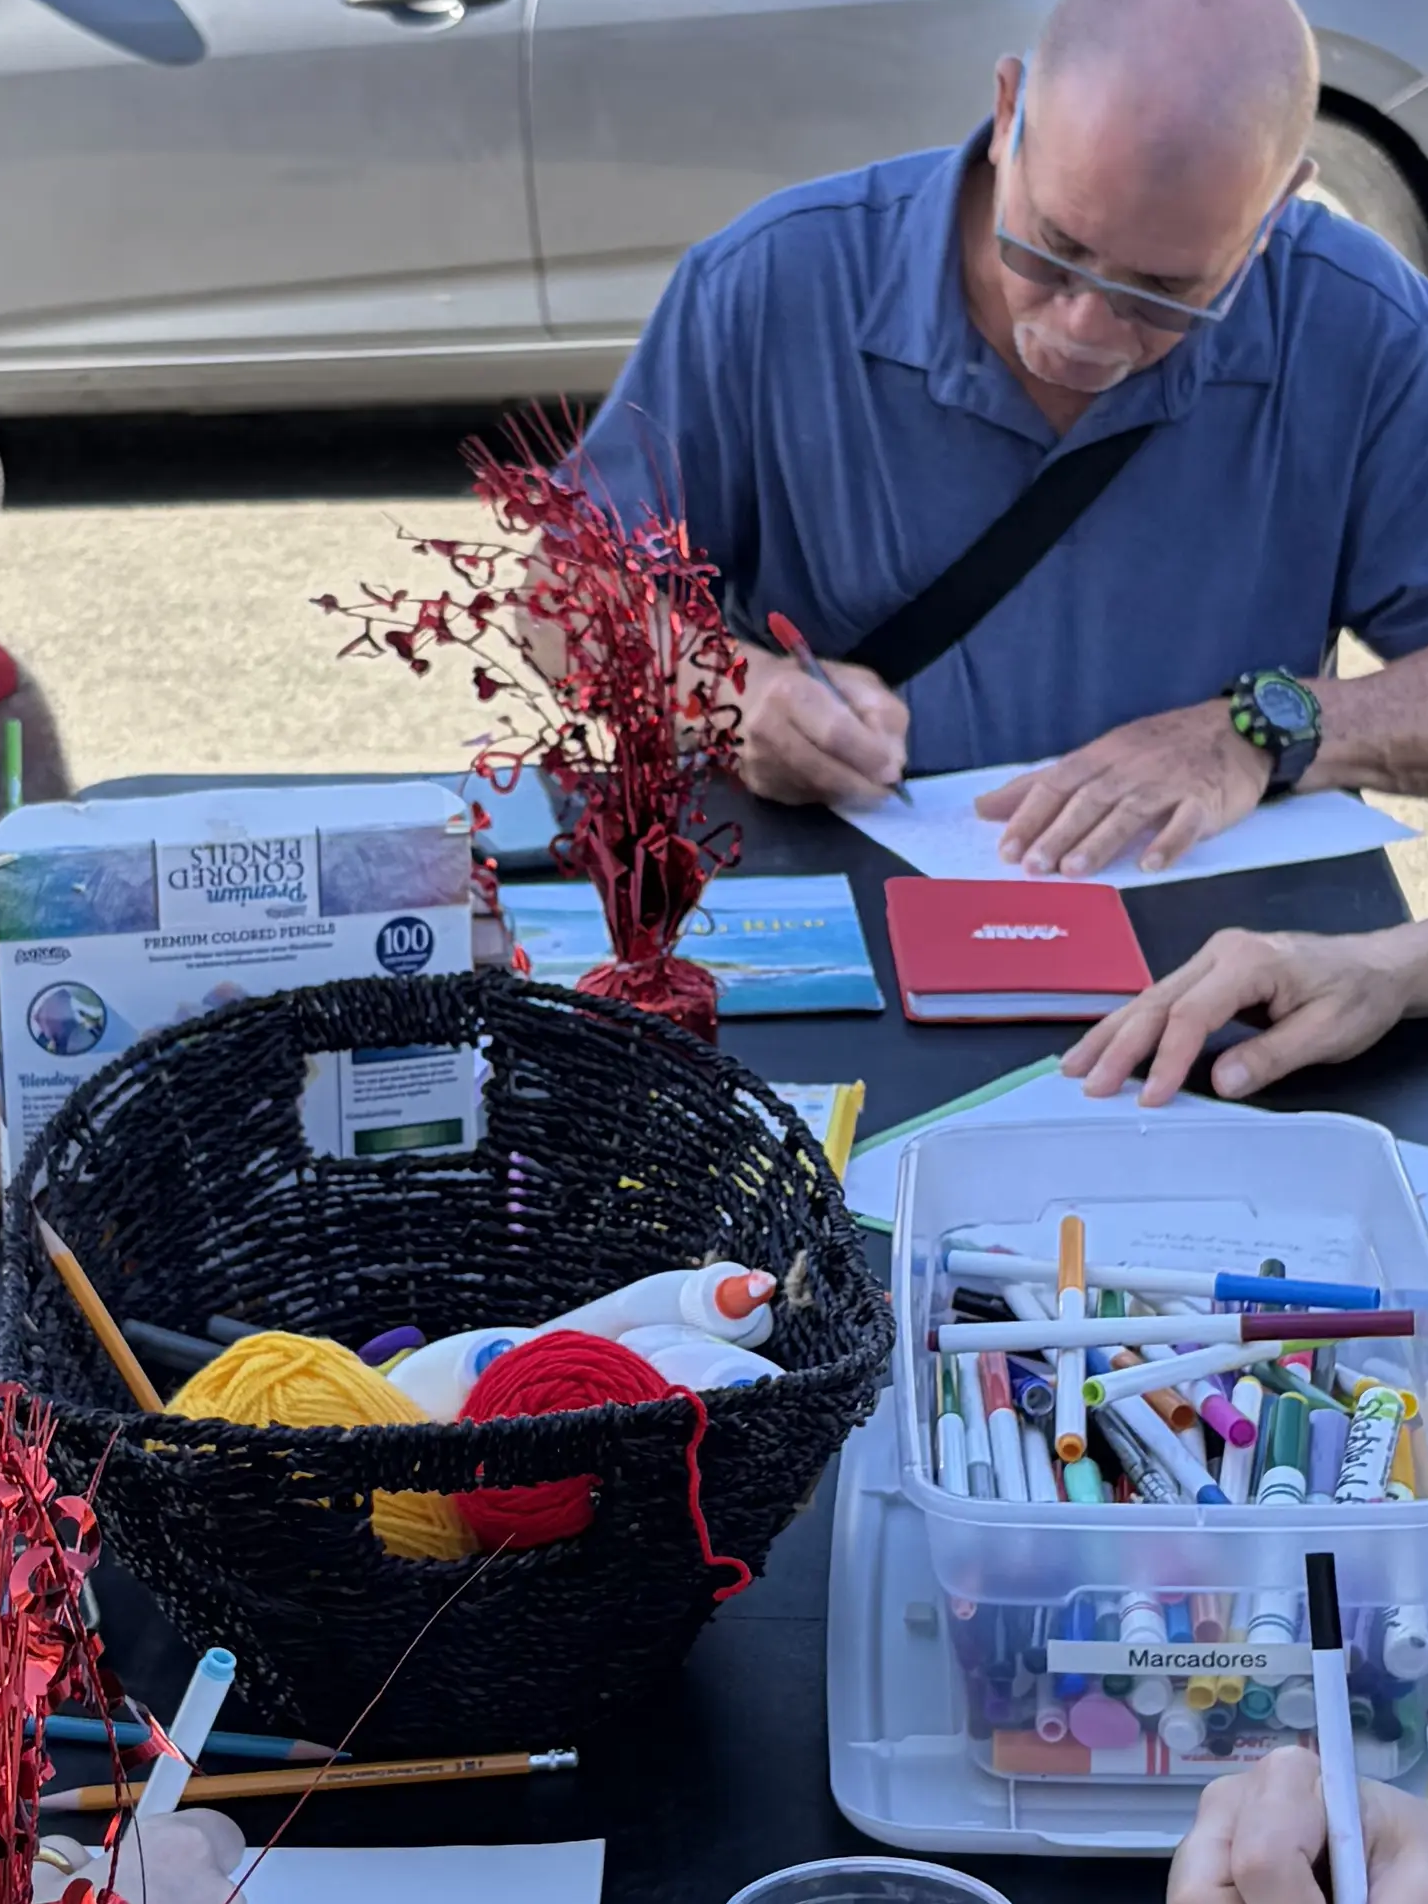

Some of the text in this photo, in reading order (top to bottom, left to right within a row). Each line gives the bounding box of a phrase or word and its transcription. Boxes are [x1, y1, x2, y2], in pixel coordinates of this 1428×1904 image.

[190, 839, 301, 866] PENCILS
[168, 861, 304, 889] COLORED
[207, 882, 307, 907] Premium
[144, 922, 335, 949] PREMIUM COLORED PENCILS
[382, 923, 430, 955] 100
[1128, 1648, 1267, 1670] Marcadores
